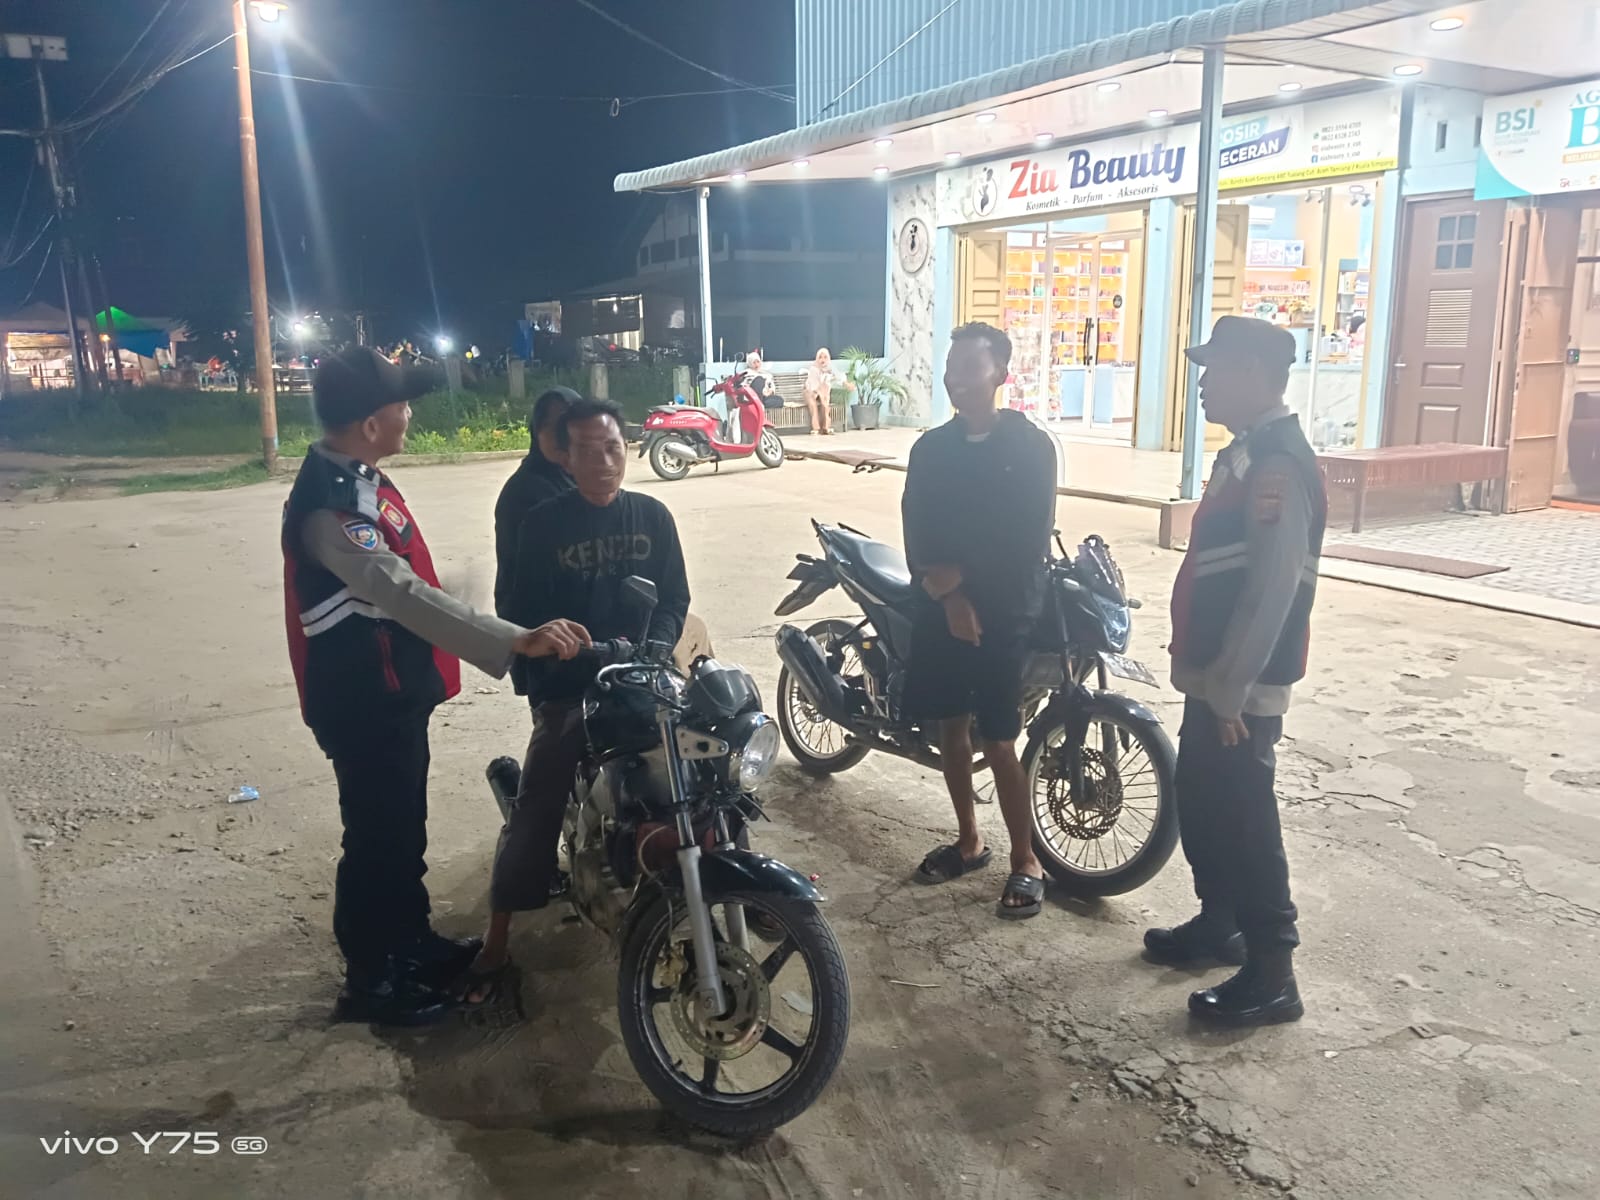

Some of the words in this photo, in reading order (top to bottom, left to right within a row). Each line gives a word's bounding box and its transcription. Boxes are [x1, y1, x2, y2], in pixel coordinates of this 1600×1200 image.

[1219, 121, 1261, 144] OSIR
[1494, 107, 1537, 134] BSI
[1219, 137, 1280, 167] ECERAN
[1008, 159, 1059, 199] Zia
[1068, 143, 1186, 189] Beauty
[1026, 197, 1060, 211] Kosmetik
[1072, 191, 1103, 205] Parfum
[1117, 184, 1159, 198] Aksesoris
[557, 533, 651, 570] KENZO
